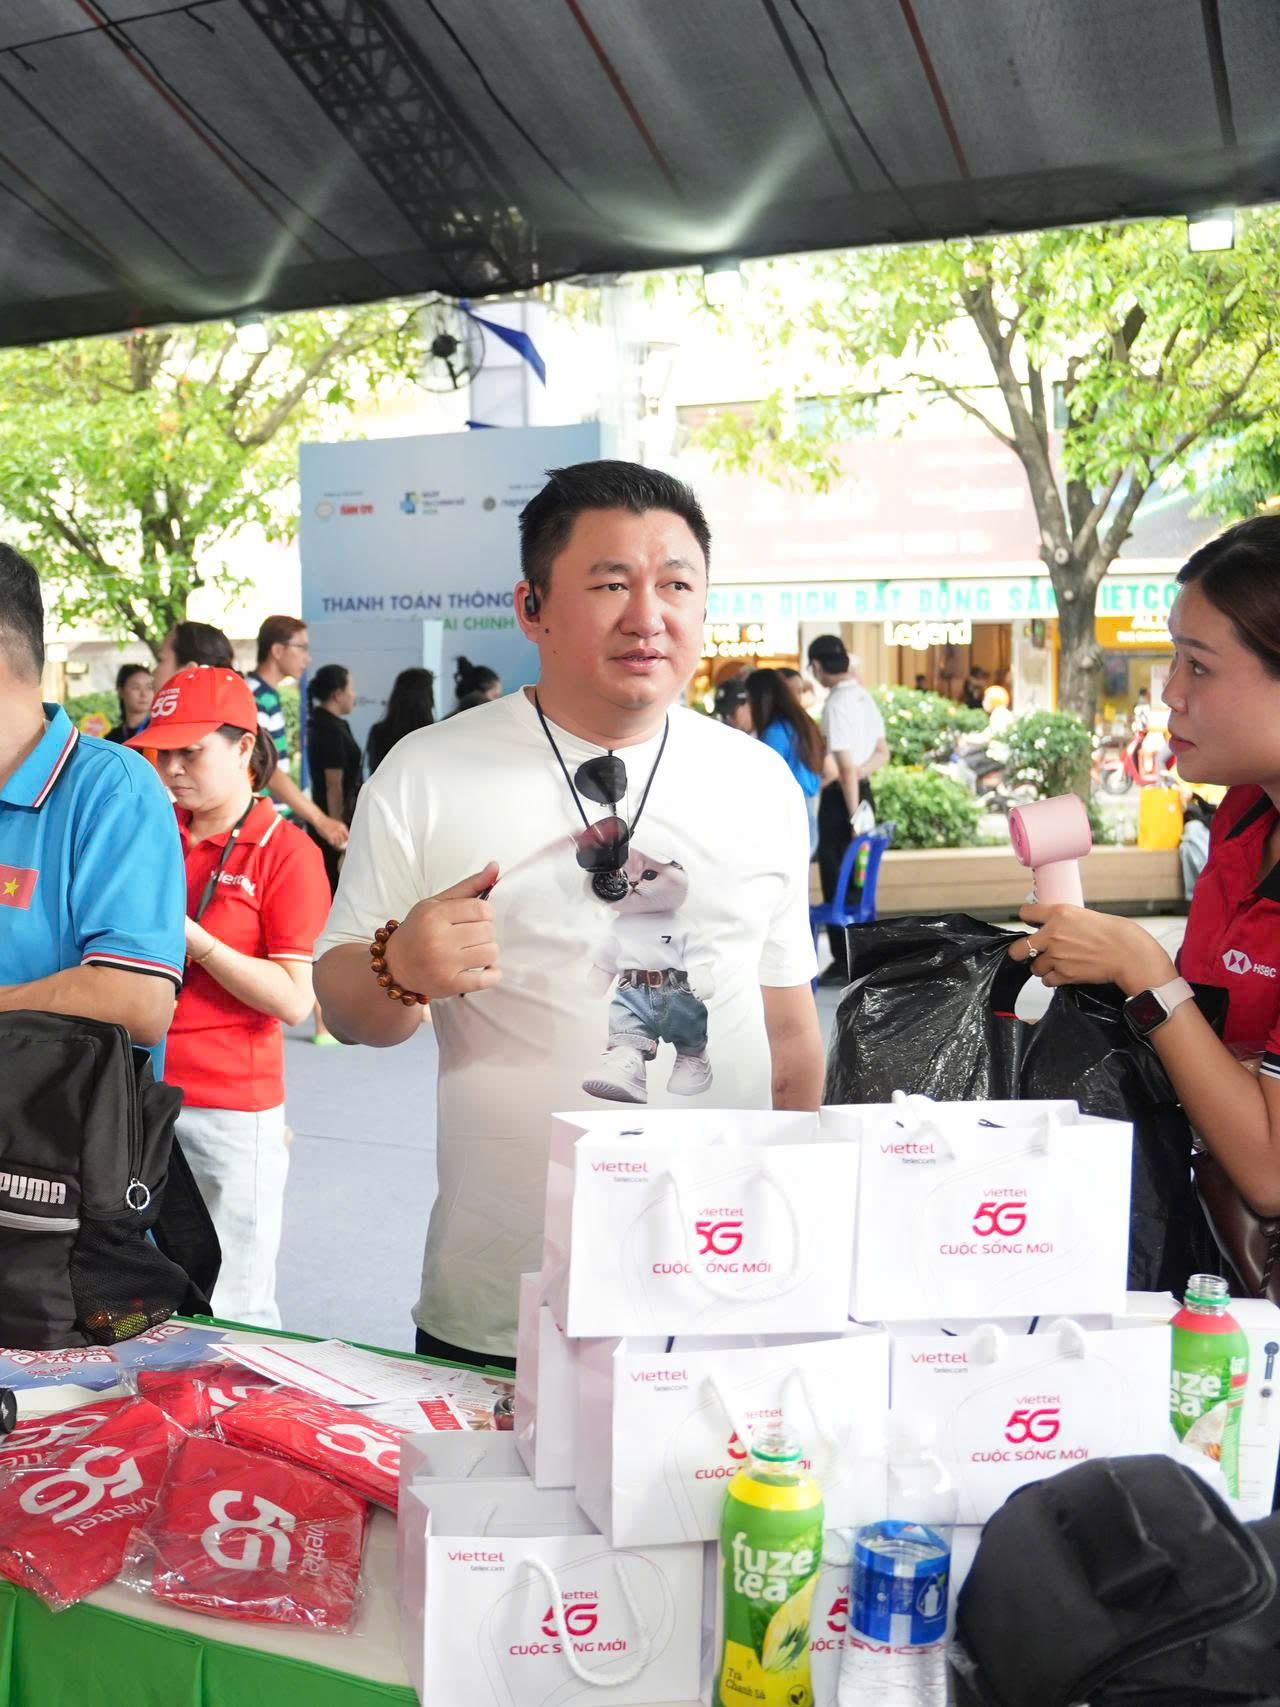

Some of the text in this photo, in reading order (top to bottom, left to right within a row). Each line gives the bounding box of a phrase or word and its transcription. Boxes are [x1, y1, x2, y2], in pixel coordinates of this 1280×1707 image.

[321, 589, 514, 613] THANH TOÁN THÔNG
[884, 619, 972, 651] Legend
[1252, 963, 1277, 978] HSBC
[880, 1143, 935, 1155] viettel
[591, 1160, 648, 1174] viettel
[983, 1188, 1028, 1198] viettel
[696, 1206, 744, 1217] viettel
[972, 1202, 1027, 1237] 5G
[694, 1221, 743, 1256] 5G
[940, 1237, 1053, 1256] CUỘC SỐNG MỚI
[652, 1259, 694, 1276] CUỘC
[706, 1257, 740, 1274] ỐNG
[911, 1352, 968, 1363] viettel
[631, 1369, 688, 1382] viettel
[1016, 1394, 1060, 1405] viettel
[1170, 1390, 1201, 1417] ea
[746, 1408, 783, 1420] iettel
[1005, 1408, 1060, 1444] 5G
[971, 1446, 1088, 1463] CUỘC SỐNG MỚI
[20, 1446, 144, 1525] 5G
[62, 1497, 158, 1537] viettel
[201, 1489, 297, 1573] 5G
[299, 1522, 325, 1577] viettel
[448, 1552, 504, 1563] viettel
[732, 1532, 814, 1577] fuze
[734, 1567, 788, 1602] tea
[561, 1590, 599, 1600] iettel
[510, 1639, 626, 1656] CUỘC SNG MỚI
